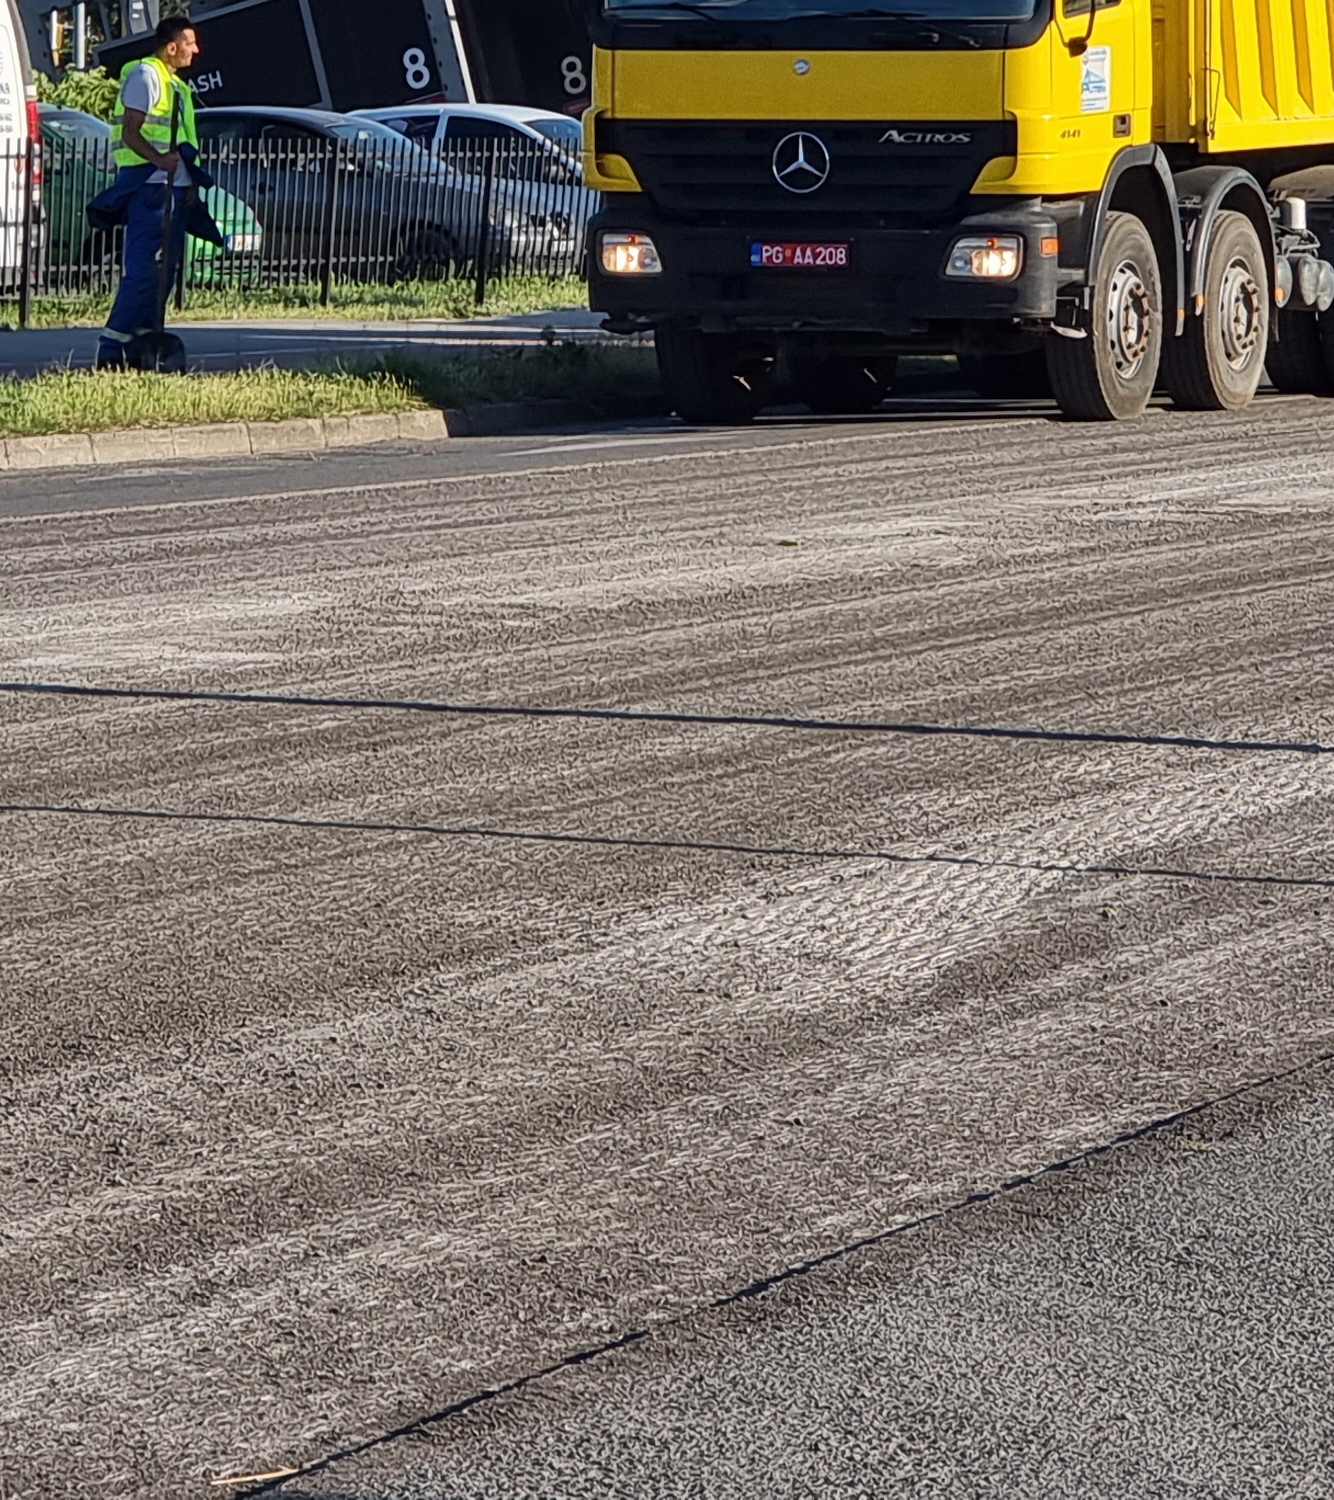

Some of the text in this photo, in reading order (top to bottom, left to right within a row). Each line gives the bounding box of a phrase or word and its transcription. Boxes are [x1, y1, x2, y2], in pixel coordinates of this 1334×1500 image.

[188, 70, 223, 94] ASH
[403, 48, 430, 89] 8
[561, 56, 587, 94] 8
[762, 245, 847, 265] PG AA208
